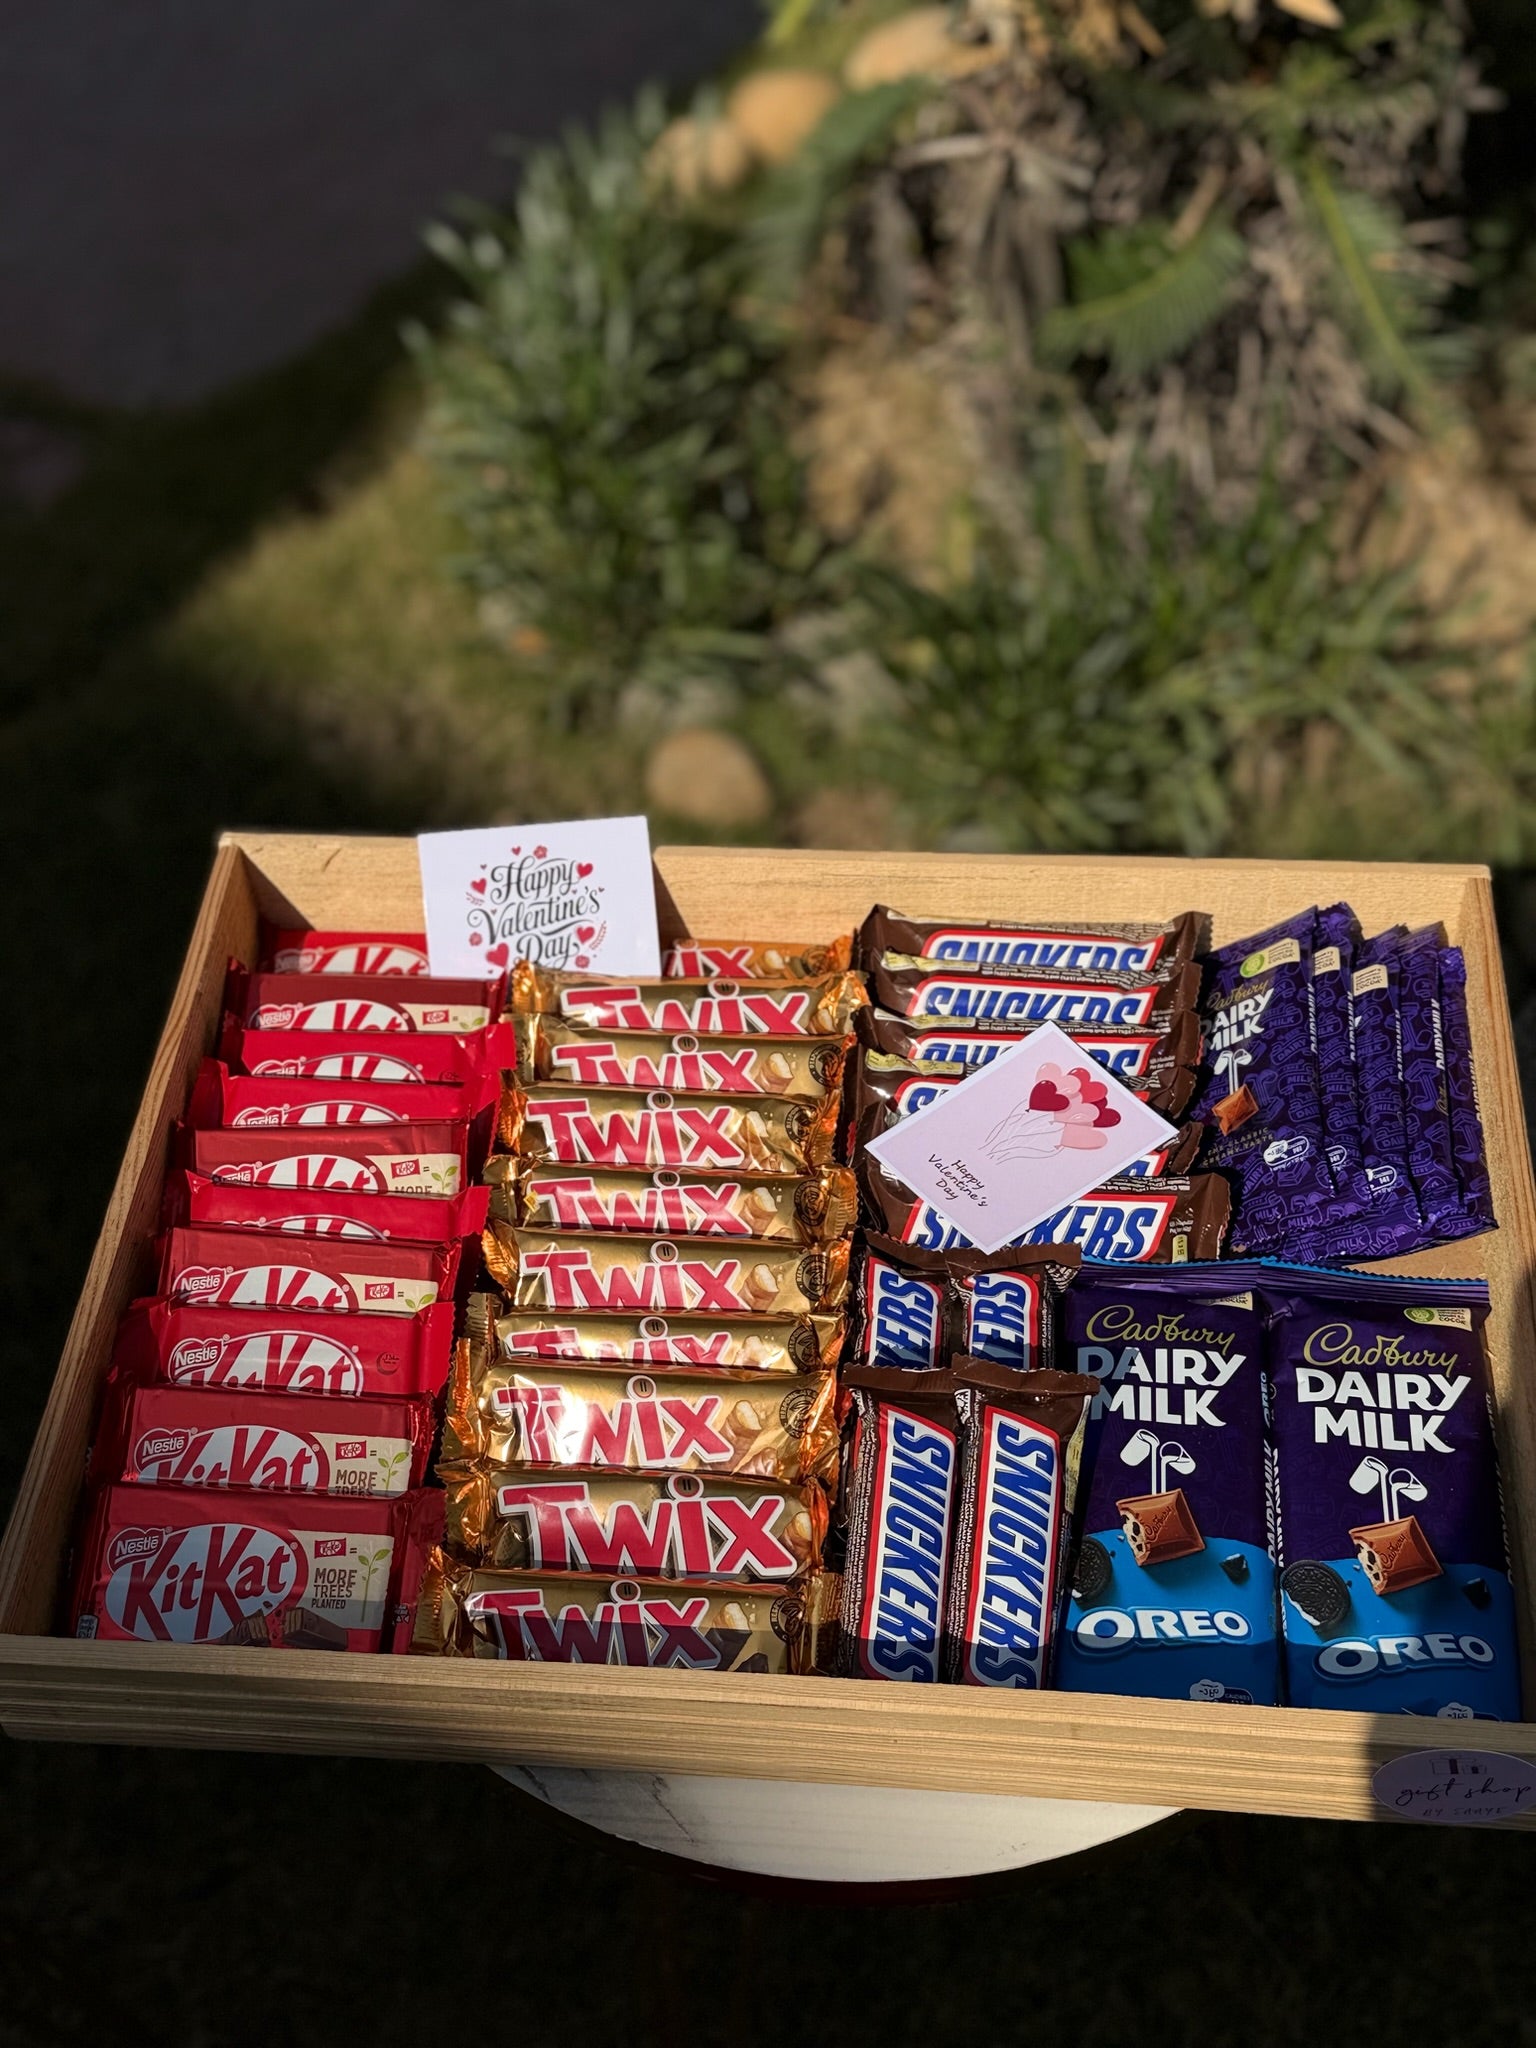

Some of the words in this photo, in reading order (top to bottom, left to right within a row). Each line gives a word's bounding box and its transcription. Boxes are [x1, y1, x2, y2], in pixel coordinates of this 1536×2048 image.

[490, 855, 583, 904] Happy
[466, 886, 601, 945] Valentine's
[513, 933, 580, 970] Day
[552, 1034, 765, 1093] Twix
[526, 1090, 746, 1167] Twix
[928, 1153, 988, 1207] Valentine's
[935, 1177, 959, 1200] Day
[951, 1159, 985, 1190] Happy
[528, 1170, 751, 1238] Twix
[180, 1275, 222, 1292] Nestlé
[519, 1241, 751, 1311] Twix
[1085, 1304, 1237, 1355] Cadbury
[1302, 1323, 1460, 1377] Cadbury
[173, 1345, 219, 1365] Nestlé
[1076, 1345, 1248, 1388] DAIRY
[1089, 1385, 1228, 1428] MILK
[1295, 1366, 1472, 1413] DAIRY
[142, 1431, 186, 1455] Nestlé
[1313, 1405, 1457, 1454] MILK
[335, 1469, 378, 1488] MORE
[115, 1535, 160, 1557] Nestlé
[496, 1473, 798, 1580] Twix
[872, 1417, 951, 1683] SNICKERS
[974, 1419, 1056, 1690] SNICKERS
[121, 1525, 292, 1643] KitKat
[313, 1567, 358, 1589] MORE
[313, 1584, 353, 1598] TREES
[311, 1598, 346, 1610] PLANTED
[467, 1580, 722, 1670] Twix
[1076, 1607, 1250, 1650] OREO
[1317, 1633, 1495, 1678] OREO
[1395, 1777, 1464, 1807] gift
[1464, 1776, 1532, 1803] shop
